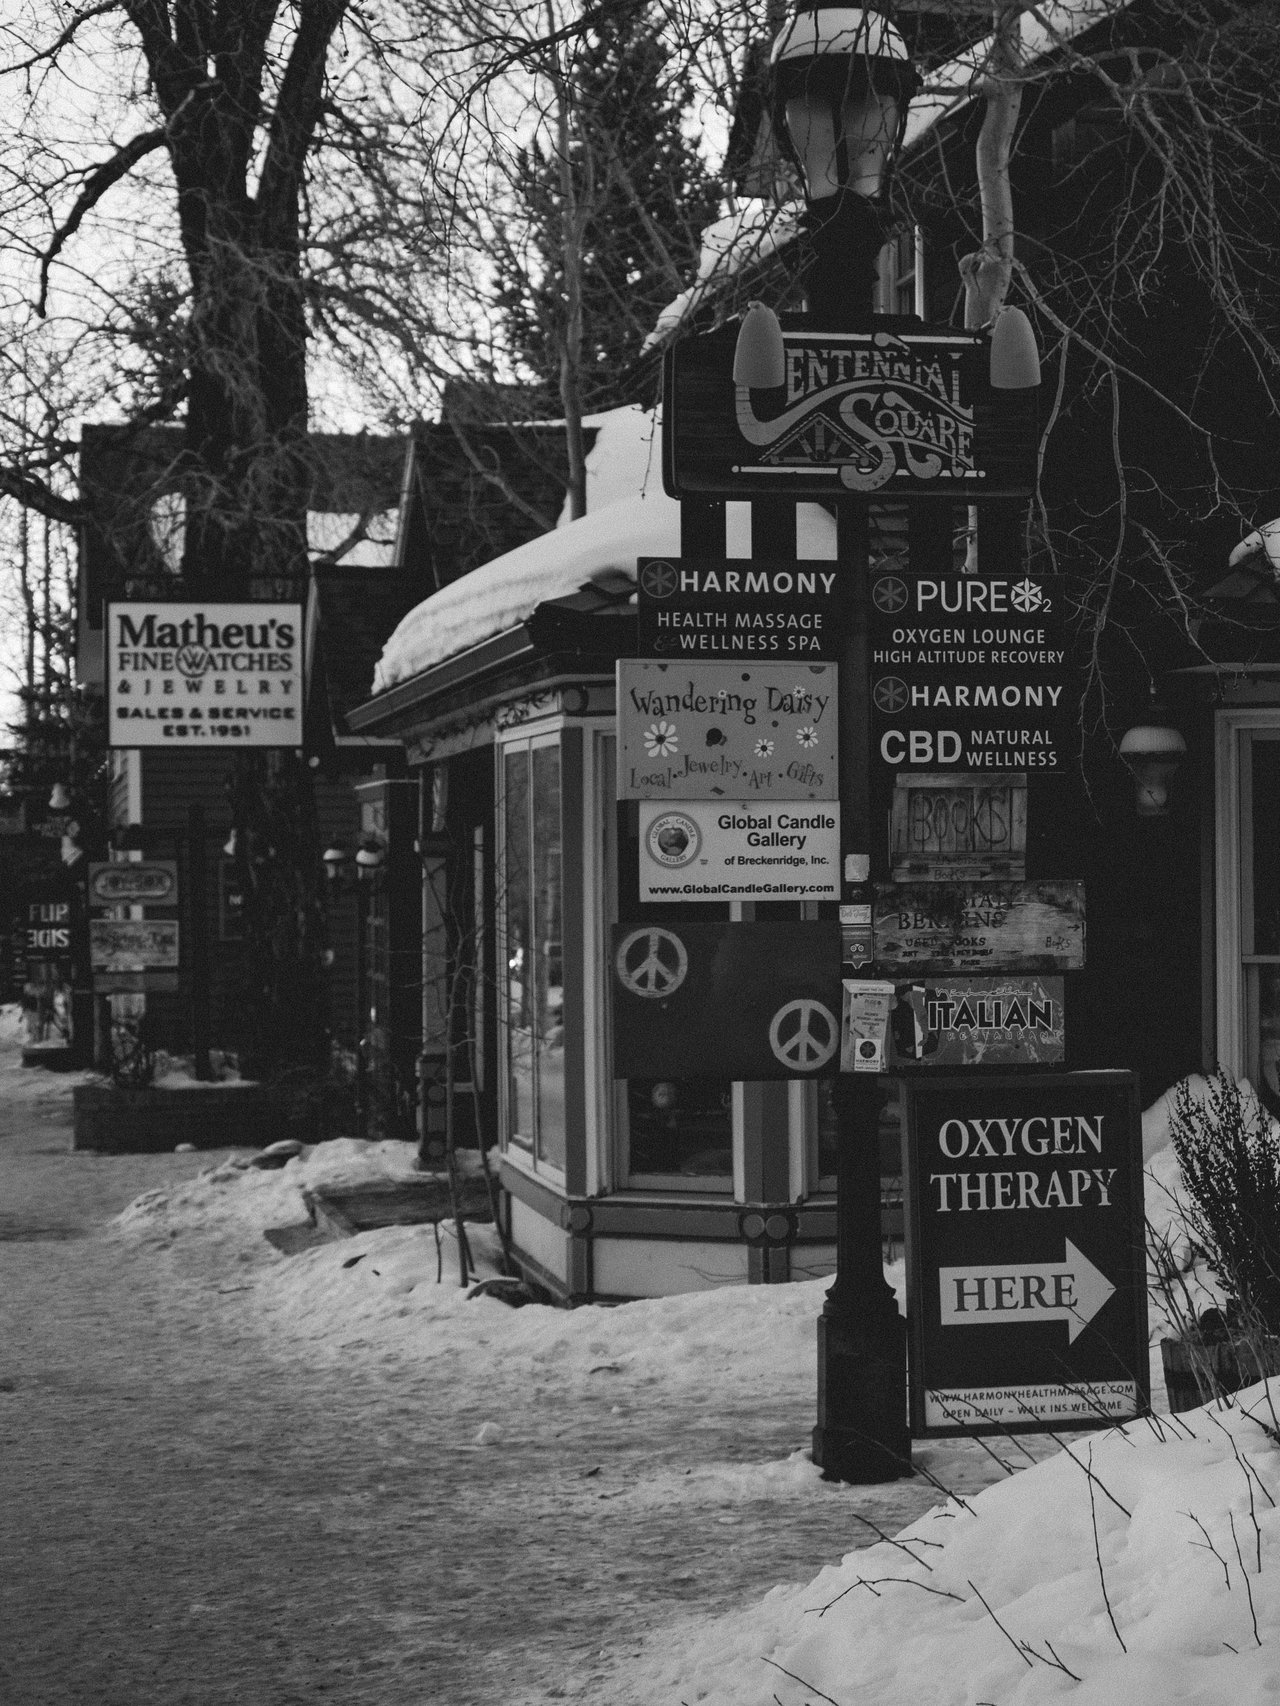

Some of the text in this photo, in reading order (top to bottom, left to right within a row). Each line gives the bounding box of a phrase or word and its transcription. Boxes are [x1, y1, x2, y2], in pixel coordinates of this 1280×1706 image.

[839, 391, 976, 491] SQUARE
[680, 570, 836, 594] HARMONY
[657, 612, 823, 629] HEALTH MASSAGE
[117, 613, 295, 649] Matheu's
[892, 628, 1046, 644] OXYGEN LOUNGE
[679, 634, 779, 650] WELLNESS
[788, 635, 821, 651] SPA
[118, 647, 293, 672] FINE WATCHES
[873, 650, 1065, 664] HIGH ALTITUDE RECOVERY
[117, 679, 293, 695] & JEWELRY
[911, 685, 1063, 707] HARMONY
[629, 680, 830, 725] Wandering Daisy
[116, 707, 295, 719] SALES & SERVICE
[163, 725, 206, 737] EST.
[971, 730, 1053, 745] NATURAL
[880, 730, 962, 764] CBD
[966, 751, 1057, 766] WELLNESS
[630, 754, 824, 789] Local Jewelry Art Gifts
[718, 814, 835, 830] Global Candle
[912, 794, 1008, 845] BOOKS
[747, 832, 807, 850] Gallery
[724, 856, 829, 867] of Breckenridge, Inc.
[648, 883, 834, 895] www.GlobalCandleGallery.com
[29, 903, 69, 922] FLIP
[950, 937, 986, 947] OOKS
[928, 997, 1053, 1031] ITALIAN
[938, 1115, 1105, 1159] OXYGEN
[930, 1168, 1117, 1212] THERAPY
[952, 1273, 1079, 1312] HERE
[942, 1408, 971, 1419] OPEN
[975, 1407, 1004, 1418] DAILY
[1017, 1405, 1046, 1415] WALK
[1050, 1404, 1068, 1413] INS
[1071, 1401, 1123, 1413] WELCOME
